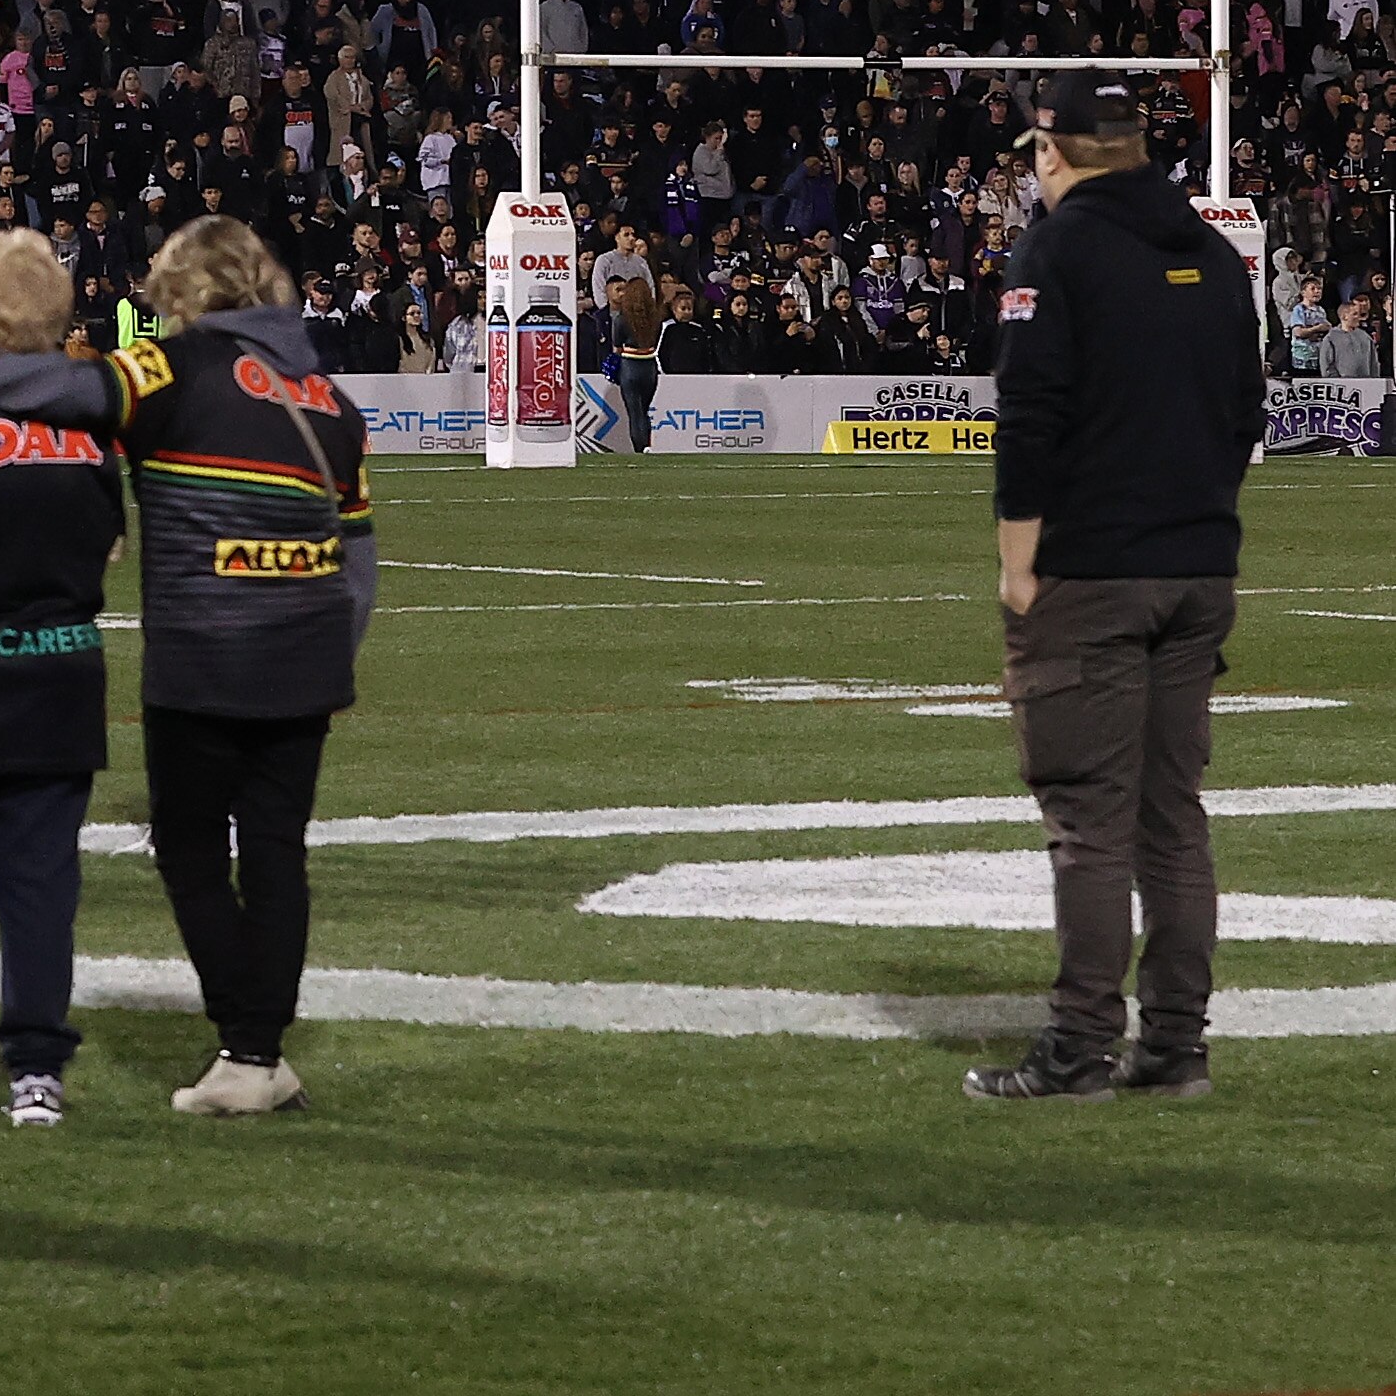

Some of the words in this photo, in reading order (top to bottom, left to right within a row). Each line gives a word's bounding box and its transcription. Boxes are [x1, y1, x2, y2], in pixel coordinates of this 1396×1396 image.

[509, 203, 567, 218] OAK
[1200, 208, 1256, 222] OAK
[489, 254, 509, 271] OAK
[519, 254, 571, 271] OAK
[533, 331, 556, 411] OAK
[876, 382, 970, 406] CASELLA
[1270, 382, 1362, 408] CASELLA
[359, 407, 486, 432] EATHER
[853, 427, 930, 450] Hertz
[952, 427, 996, 450] Her
